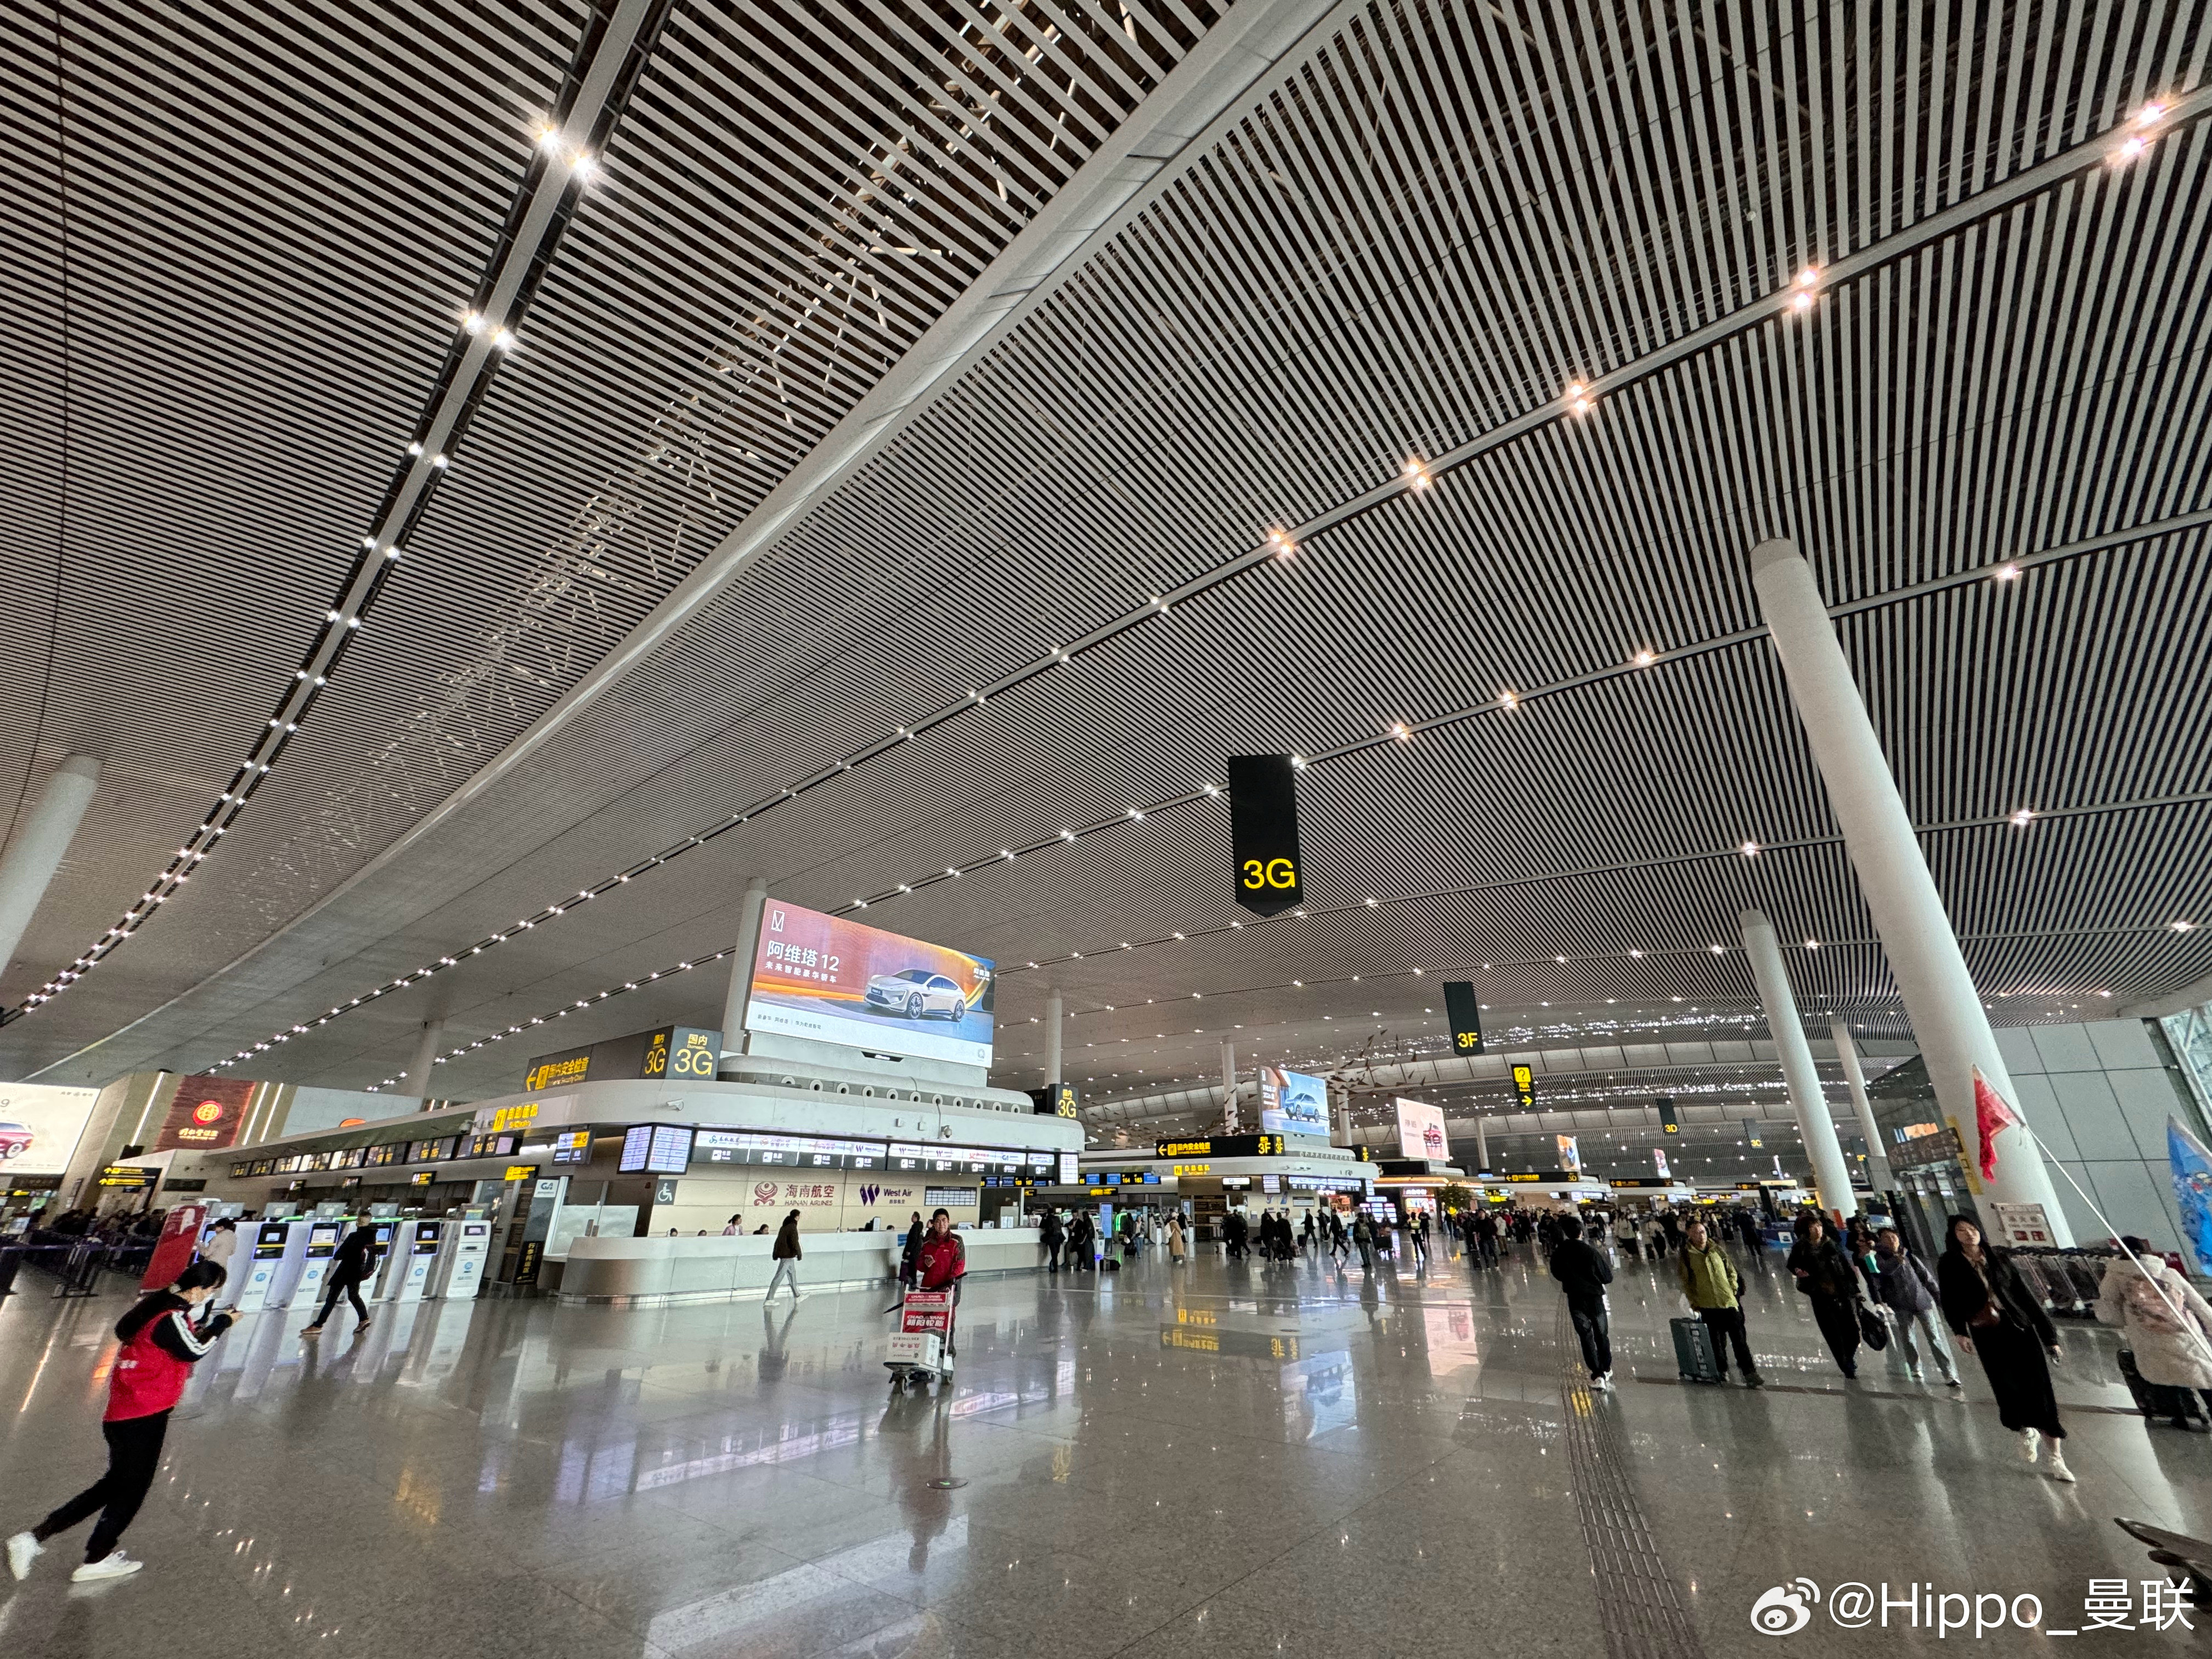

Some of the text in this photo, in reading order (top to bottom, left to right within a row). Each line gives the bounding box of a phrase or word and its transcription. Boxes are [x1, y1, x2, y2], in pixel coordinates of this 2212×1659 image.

[1244, 859, 1295, 889] 3G
[767, 940, 840, 972] 阿维塔 12
[765, 961, 837, 983] 未来智能豪华轿车
[687, 1034, 708, 1046] 国内
[1457, 1032, 1479, 1048] 3F
[548, 1056, 590, 1078] 国内安全检查
[645, 1047, 666, 1074] 3G
[674, 1048, 713, 1075] 3G
[1058, 1099, 1076, 1118] 3G
[1665, 1124, 1678, 1133] 3D
[1177, 1142, 1211, 1151] 国内安全检查
[1258, 1142, 1271, 1154] 3F
[1276, 1143, 1283, 1154] 3F
[785, 1184, 834, 1198] 海南航空
[884, 1188, 912, 1197] West Air
